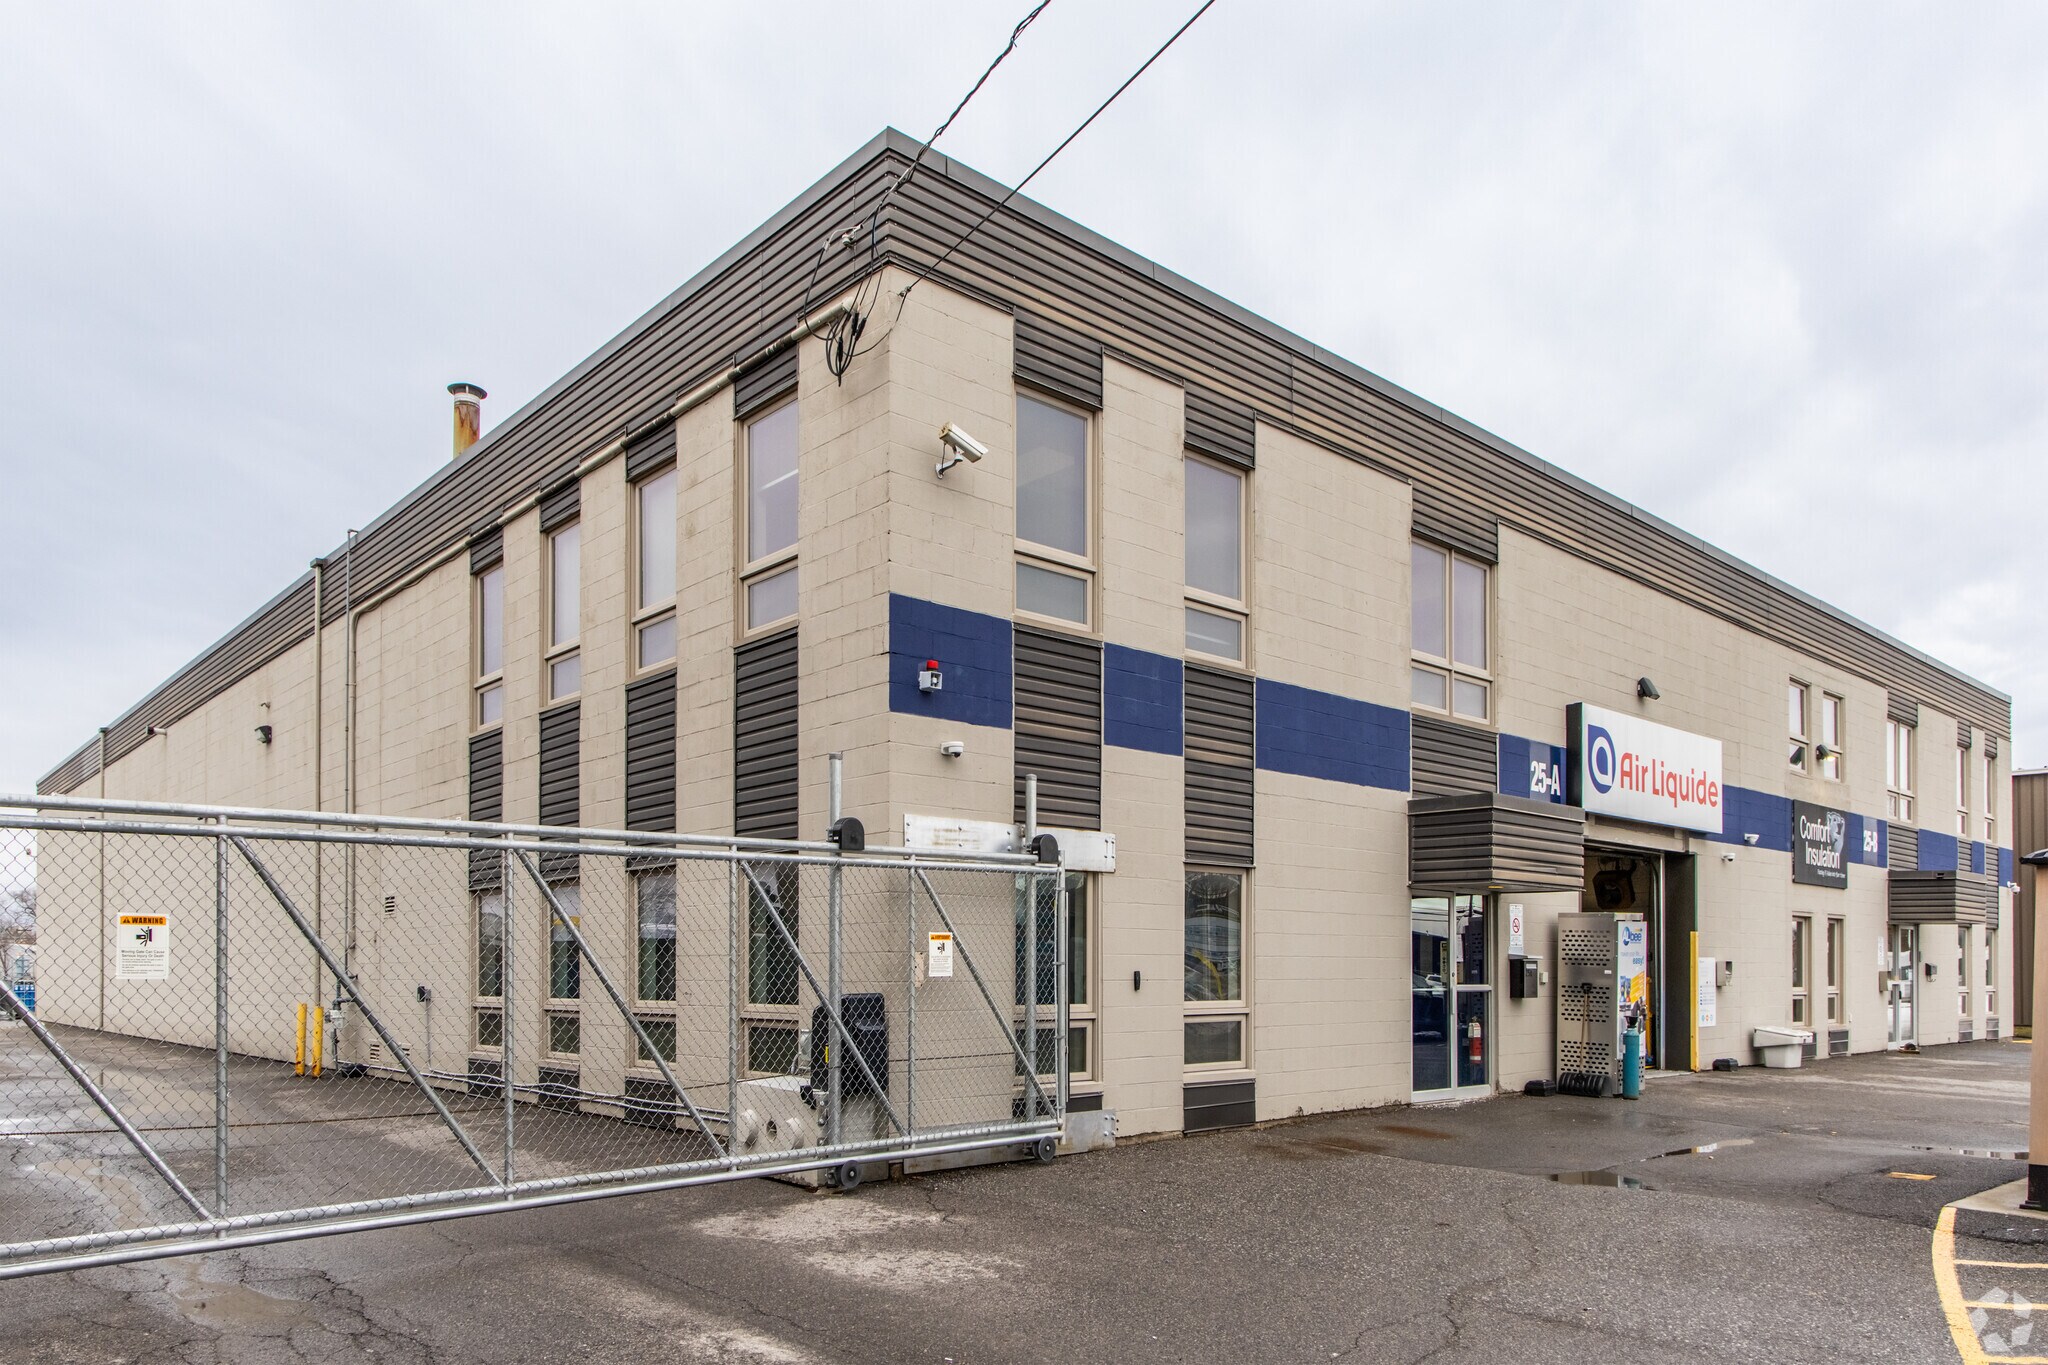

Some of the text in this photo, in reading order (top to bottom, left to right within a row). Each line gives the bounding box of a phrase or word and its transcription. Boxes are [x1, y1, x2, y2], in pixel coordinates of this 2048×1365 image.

[1530, 760, 1561, 796] 25-A
[1620, 752, 1719, 808] Air Liquide
[1800, 815, 1831, 843] Comfort
[1805, 841, 1840, 869] Insulation
